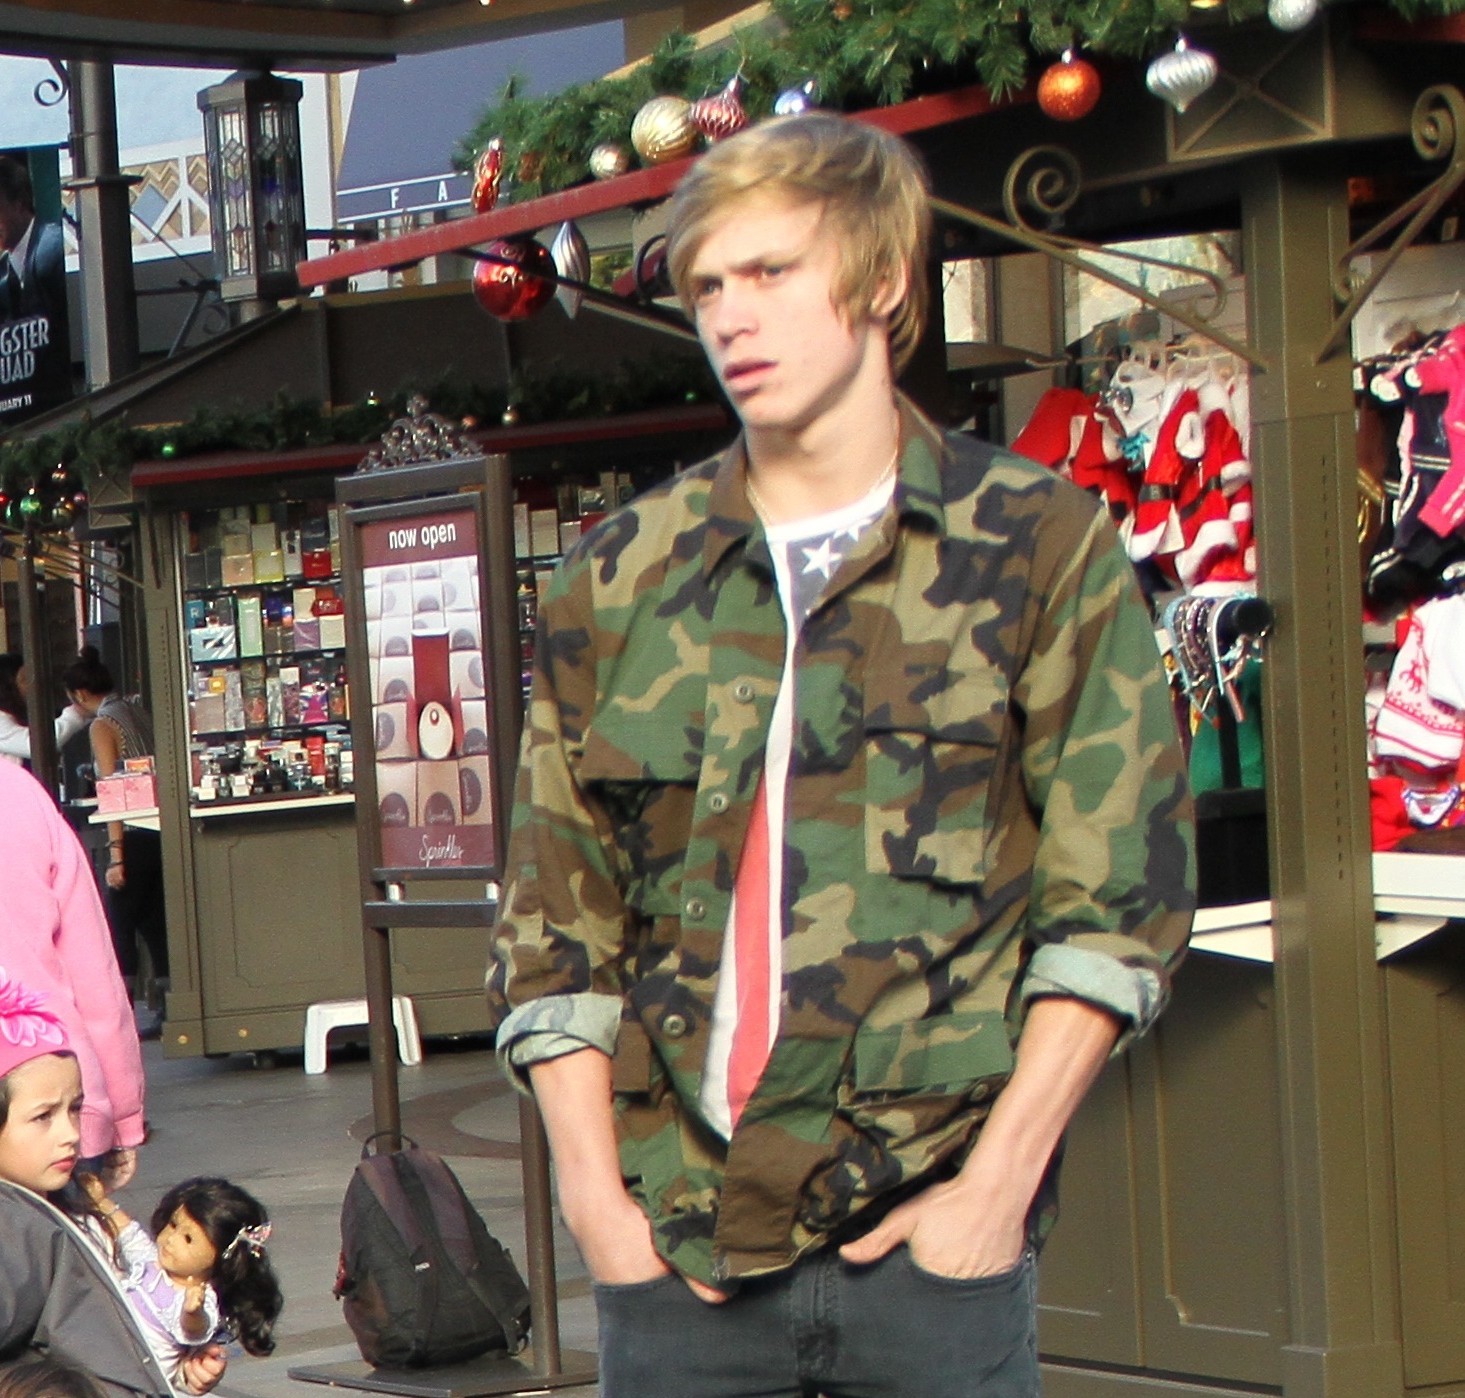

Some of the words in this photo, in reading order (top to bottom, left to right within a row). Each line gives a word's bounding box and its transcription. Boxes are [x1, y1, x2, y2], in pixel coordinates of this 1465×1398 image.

[24, 394, 32, 406] 11
[388, 527, 418, 550] now
[420, 522, 457, 551] open
